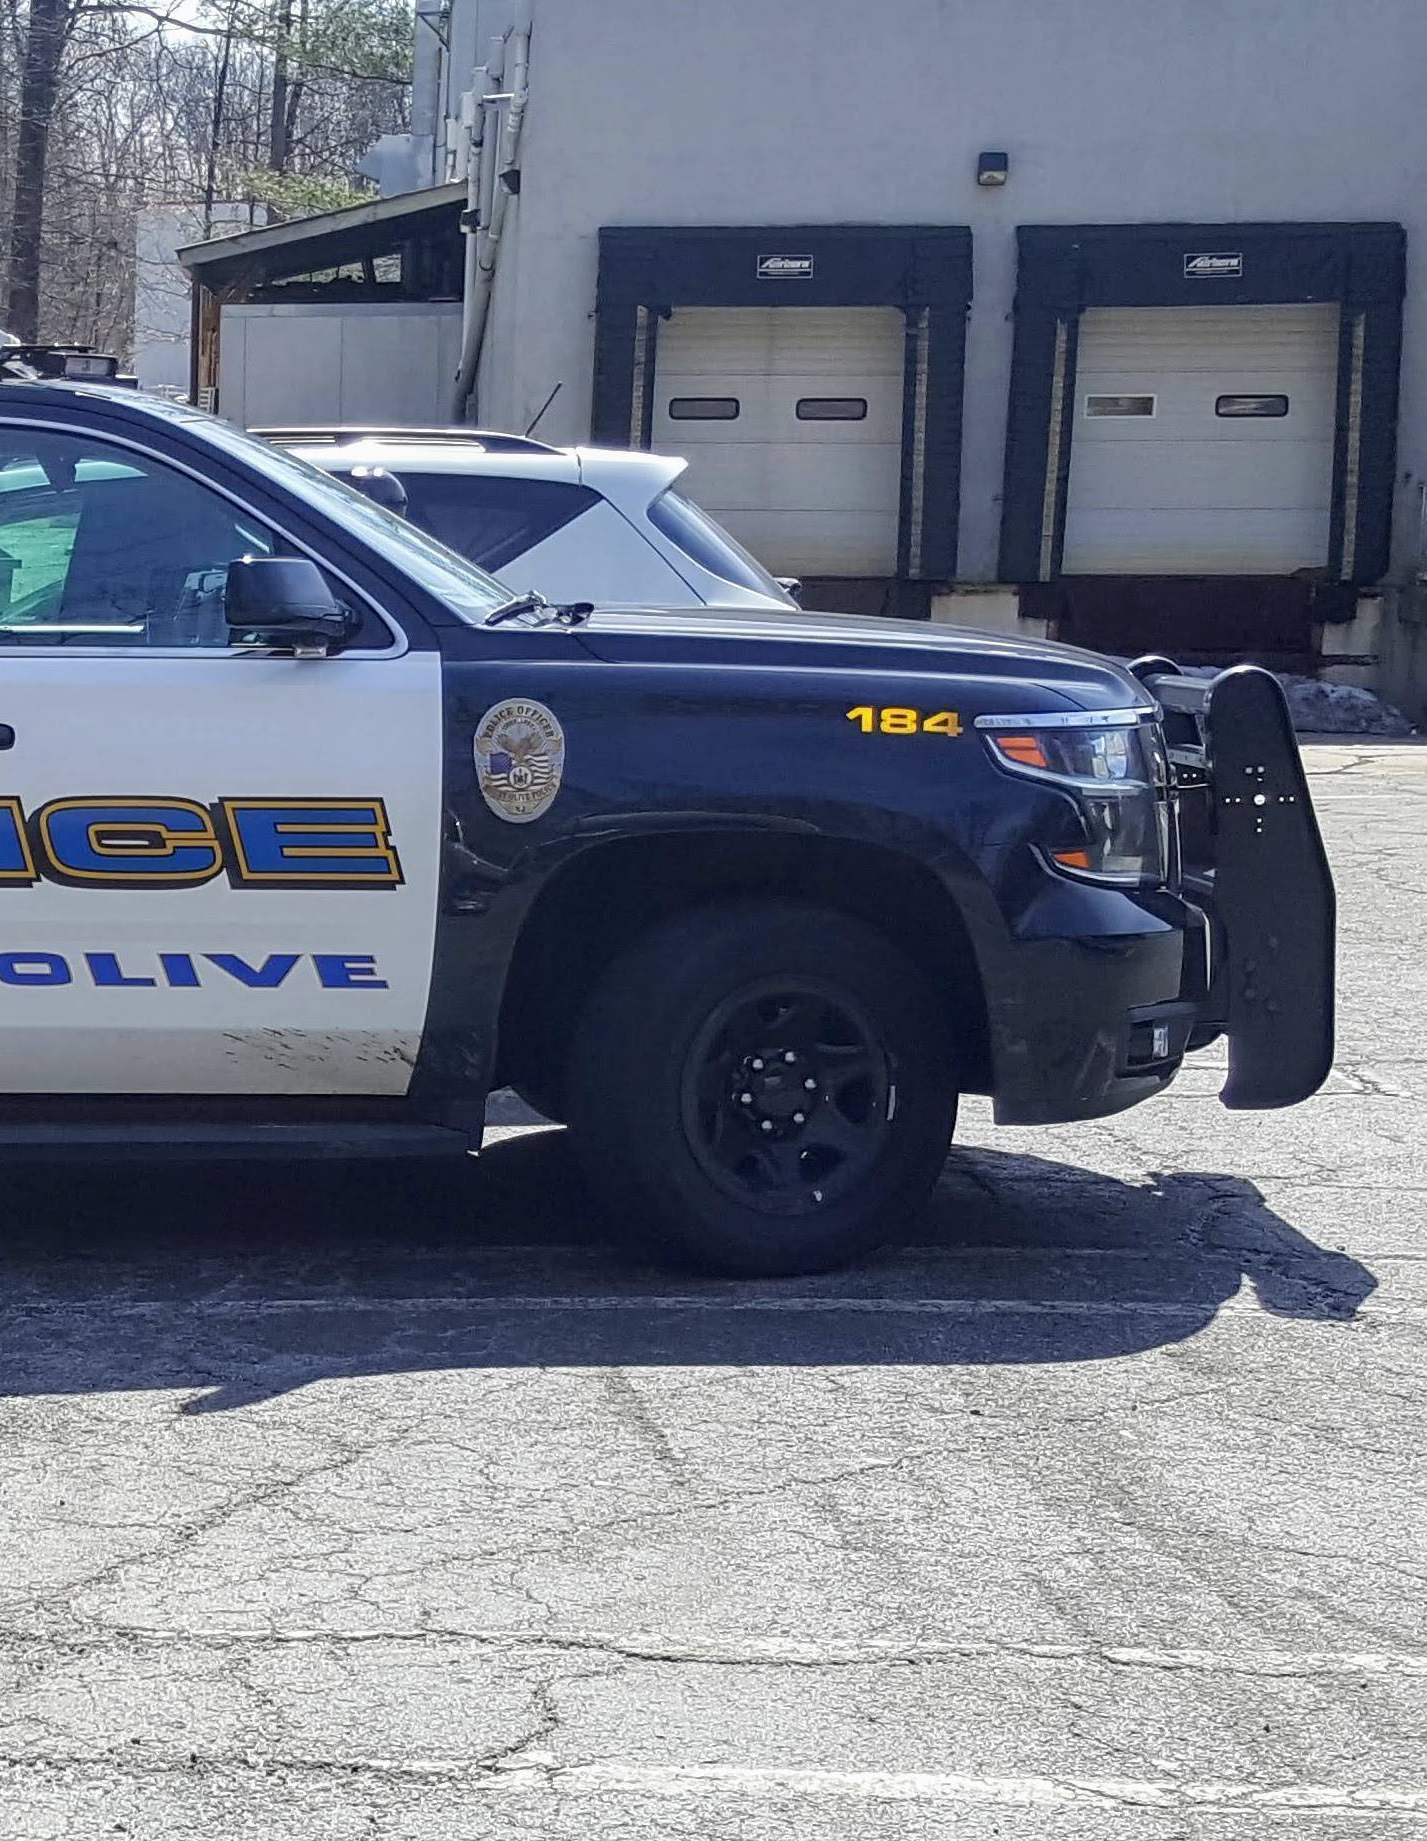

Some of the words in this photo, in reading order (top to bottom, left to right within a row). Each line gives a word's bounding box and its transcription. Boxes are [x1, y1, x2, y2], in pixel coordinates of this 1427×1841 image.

[483, 706, 515, 739] POLICE
[517, 705, 555, 738] OFFICER
[845, 706, 964, 737] 184
